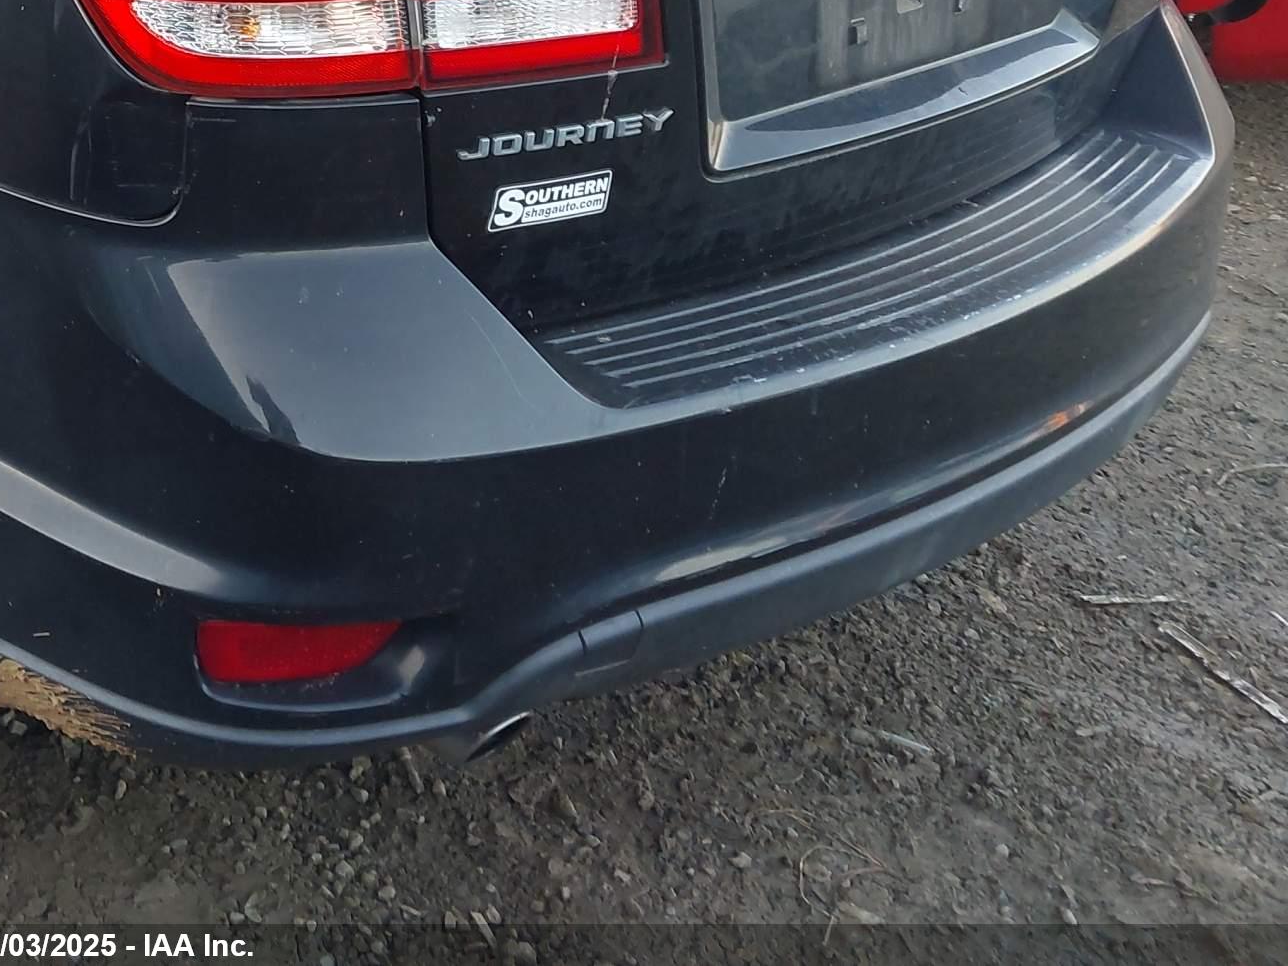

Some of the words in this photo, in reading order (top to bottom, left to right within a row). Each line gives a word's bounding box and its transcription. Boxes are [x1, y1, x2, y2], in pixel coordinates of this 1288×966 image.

[456, 107, 675, 161] JOURNEY
[494, 177, 609, 226] SOUTHERN
[524, 198, 602, 219] shagauto.com
